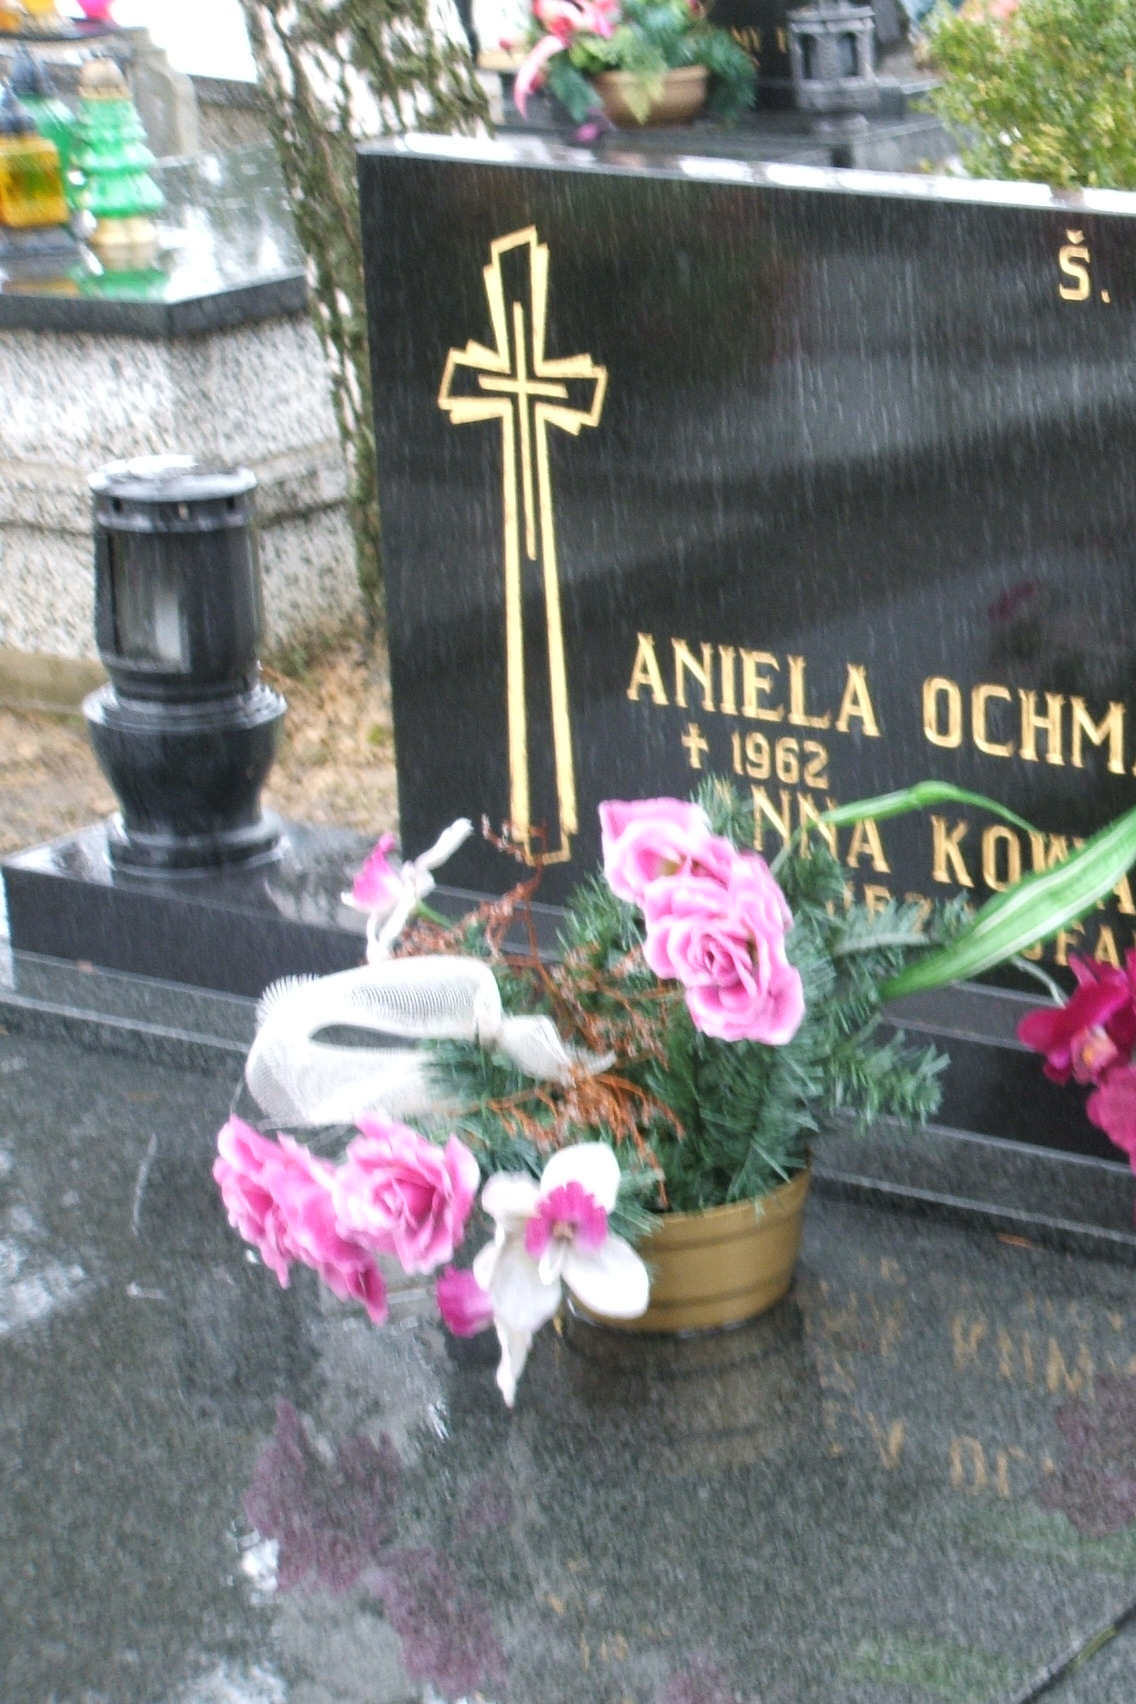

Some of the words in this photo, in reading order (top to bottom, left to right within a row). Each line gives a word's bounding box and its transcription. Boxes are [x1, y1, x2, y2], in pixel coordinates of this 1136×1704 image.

[626, 632, 881, 737] ANIELA
[731, 730, 830, 790] 1962
[714, 781, 891, 874] NNA
